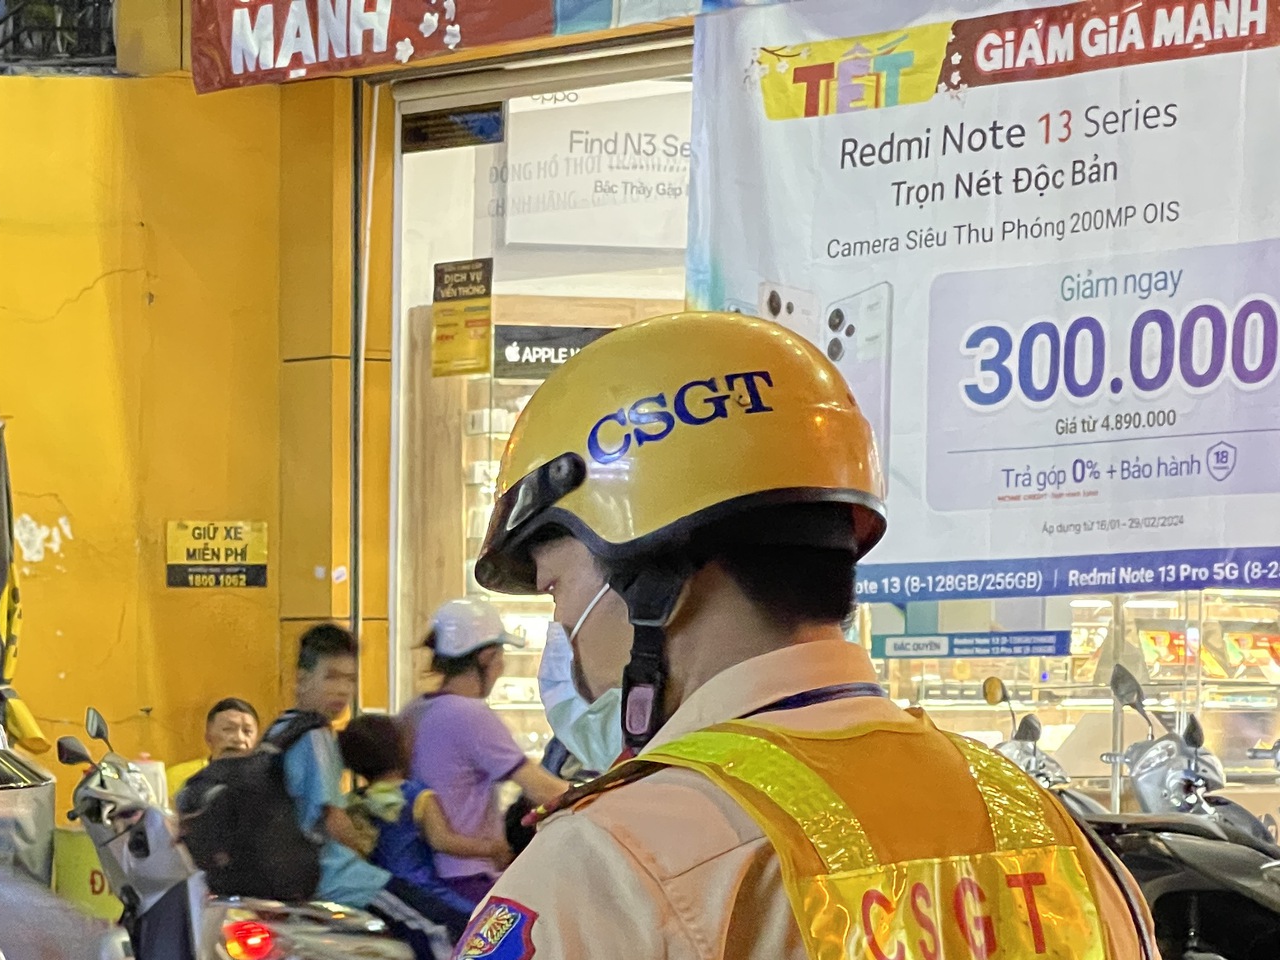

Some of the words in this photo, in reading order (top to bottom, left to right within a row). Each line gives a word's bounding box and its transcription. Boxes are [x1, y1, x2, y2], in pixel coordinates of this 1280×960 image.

[232, 0, 391, 78] MẠNH
[1152, 0, 1267, 49] MẠNH
[793, 33, 914, 117] TẾT
[570, 130, 618, 155] Find
[624, 133, 656, 156] N3
[840, 129, 931, 169] Redmi
[941, 121, 1026, 157] Note
[1037, 111, 1072, 145] 13
[1084, 99, 1178, 139] Series
[891, 180, 944, 209] Trọn
[954, 168, 1003, 200] Nét
[1013, 162, 1065, 199] Độc
[1071, 152, 1119, 188] Bản
[827, 232, 900, 260] Camera
[906, 225, 947, 250] Siêu
[953, 221, 994, 248] Thu
[1001, 215, 1066, 244] Phóng
[1070, 206, 1137, 236] 200MP
[1143, 200, 1181, 225] OIS
[1060, 268, 1119, 303] Giảm
[1123, 266, 1183, 300] ngay
[522, 346, 568, 363] APPLE
[963, 299, 1278, 406] 300.000
[588, 371, 774, 464] CSGT
[1056, 417, 1077, 437] Giá
[1081, 413, 1096, 433] từ
[1101, 409, 1176, 432] 4.890.000
[1002, 465, 1032, 488] Trả
[1036, 464, 1067, 491] góp
[1072, 457, 1100, 484] 0%
[1120, 456, 1152, 481] Bảo
[1156, 454, 1201, 478] hành
[1214, 450, 1229, 464] 18
[192, 523, 219, 541] GIỮ
[224, 526, 243, 541] XE
[186, 543, 220, 561] MIỄN
[225, 543, 248, 562] PHÍ
[882, 575, 901, 594] 13
[904, 569, 1043, 597] (8-128GB/256GB)
[1068, 567, 1116, 587] Redmi
[1119, 566, 1155, 585] Note
[1158, 564, 1176, 583] 13
[1180, 563, 1210, 581] Pro
[1213, 562, 1239, 580] 5G
[1244, 560, 1280, 583] (8-2
